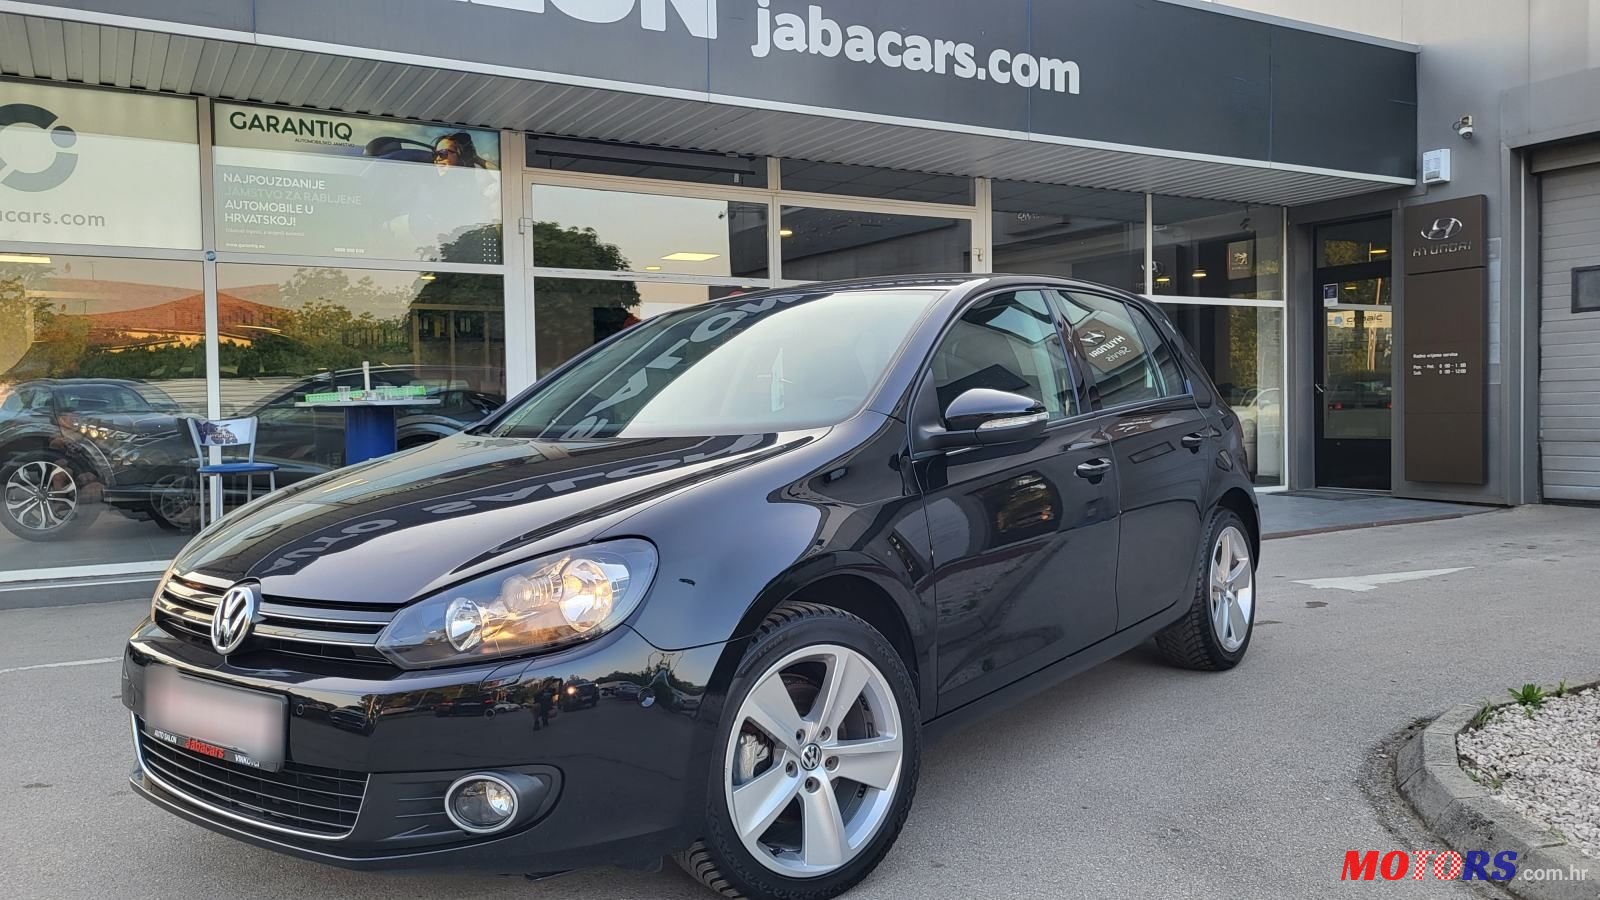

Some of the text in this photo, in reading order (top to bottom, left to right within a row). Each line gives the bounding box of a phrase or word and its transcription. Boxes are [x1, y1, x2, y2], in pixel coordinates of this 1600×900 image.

[751, 0, 1080, 94] jabacars.com
[229, 111, 353, 141] GARANTIQ
[223, 173, 326, 190] NAJPOUZDANIJE
[224, 186, 362, 206] JAMSTVO ZA RABLJENE
[224, 199, 314, 215] AUTOMOBILE U
[0, 210, 106, 227] cars.com
[224, 212, 297, 227] HRVATSKOJ!
[1412, 240, 1472, 257] HYUNDAI
